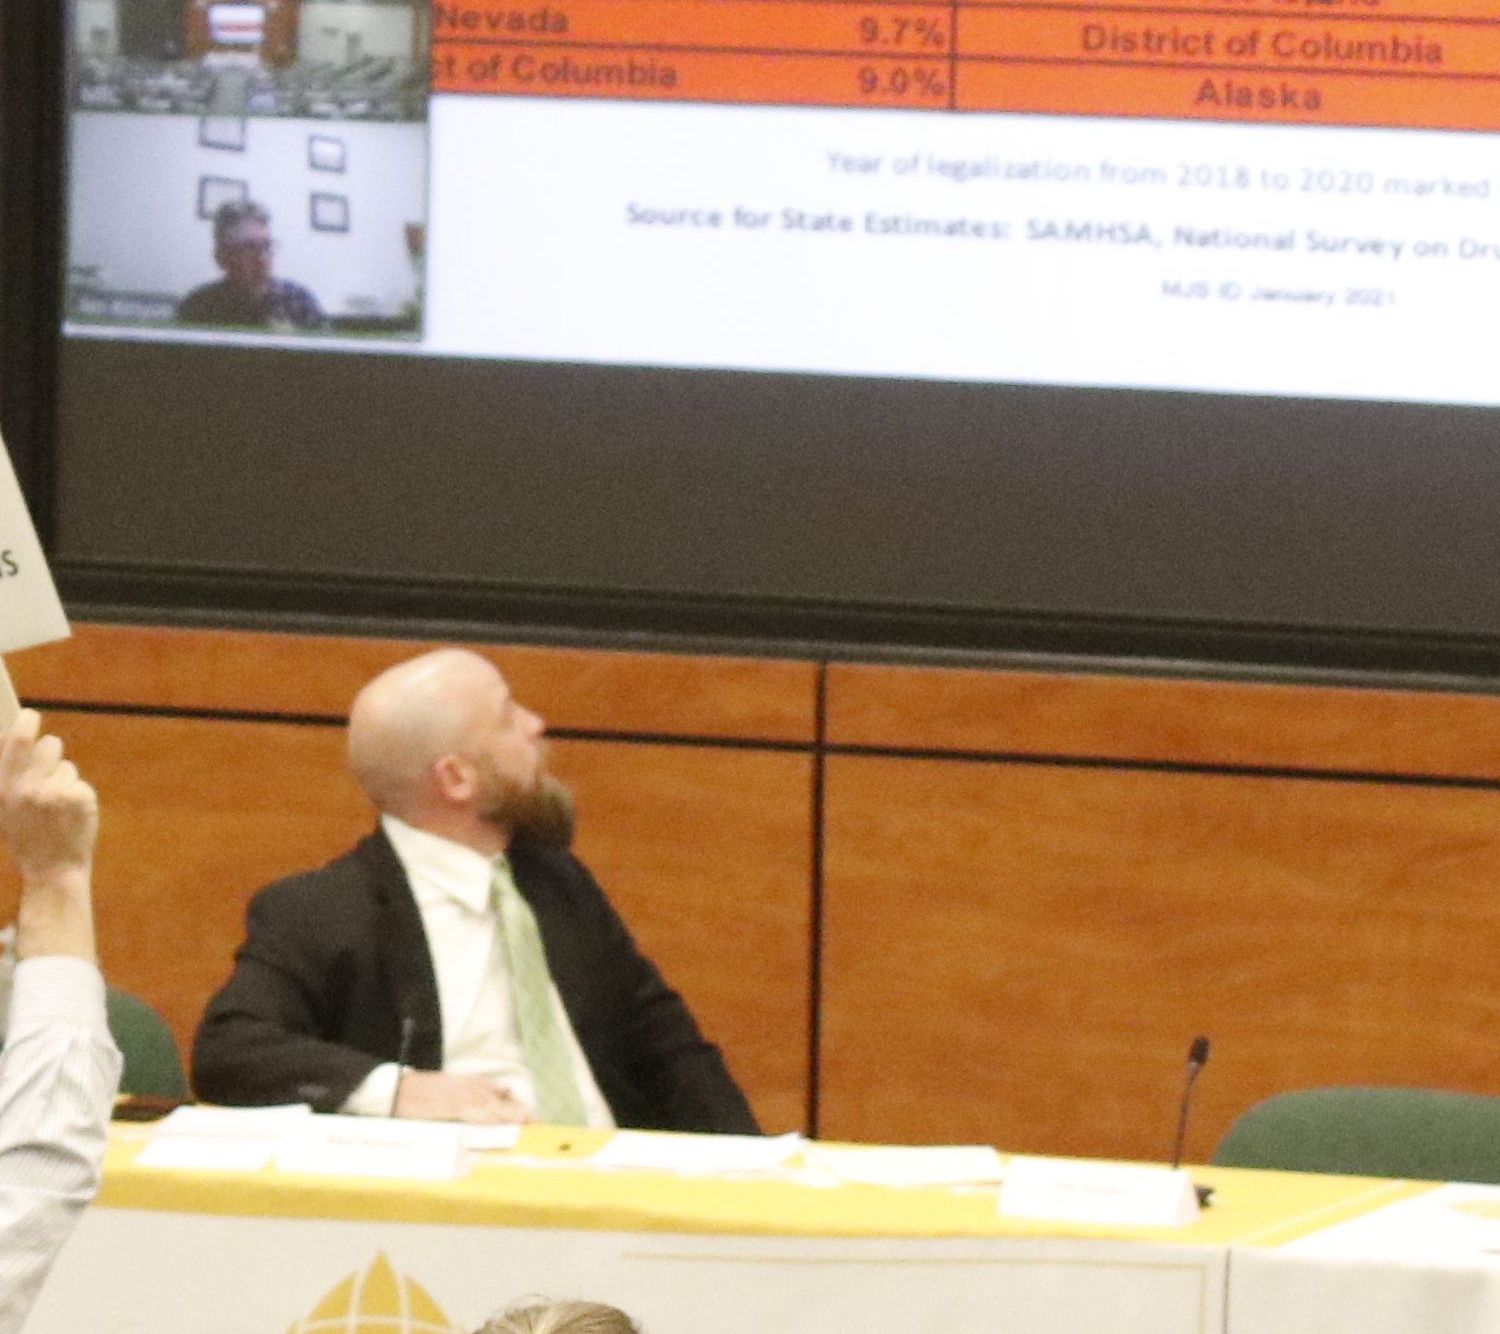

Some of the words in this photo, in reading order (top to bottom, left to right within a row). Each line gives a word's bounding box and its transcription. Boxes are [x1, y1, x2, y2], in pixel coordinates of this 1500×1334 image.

[435, 5, 569, 36] Nevada
[858, 14, 947, 45] 9.7%
[1080, 23, 1215, 57] District
[1226, 27, 1260, 58] of
[1270, 29, 1443, 66] Columbia
[469, 51, 502, 84] of
[511, 53, 679, 90] Columbia
[857, 67, 946, 98] 9.0%
[1194, 77, 1323, 112] Alaska
[826, 149, 884, 175] Year
[891, 150, 922, 176] of
[927, 152, 1092, 185] legalization
[1099, 158, 1169, 185] from
[1176, 162, 1251, 190] 2018
[1260, 166, 1291, 191] to
[1298, 168, 1375, 197] 2020
[1384, 172, 1491, 201] marked
[624, 200, 724, 230] Source
[731, 204, 773, 231] for
[780, 206, 854, 234] State
[863, 210, 1011, 239] Estimates:
[1172, 222, 1297, 253] National
[1303, 229, 1407, 263] Survey
[1411, 237, 1450, 259] on
